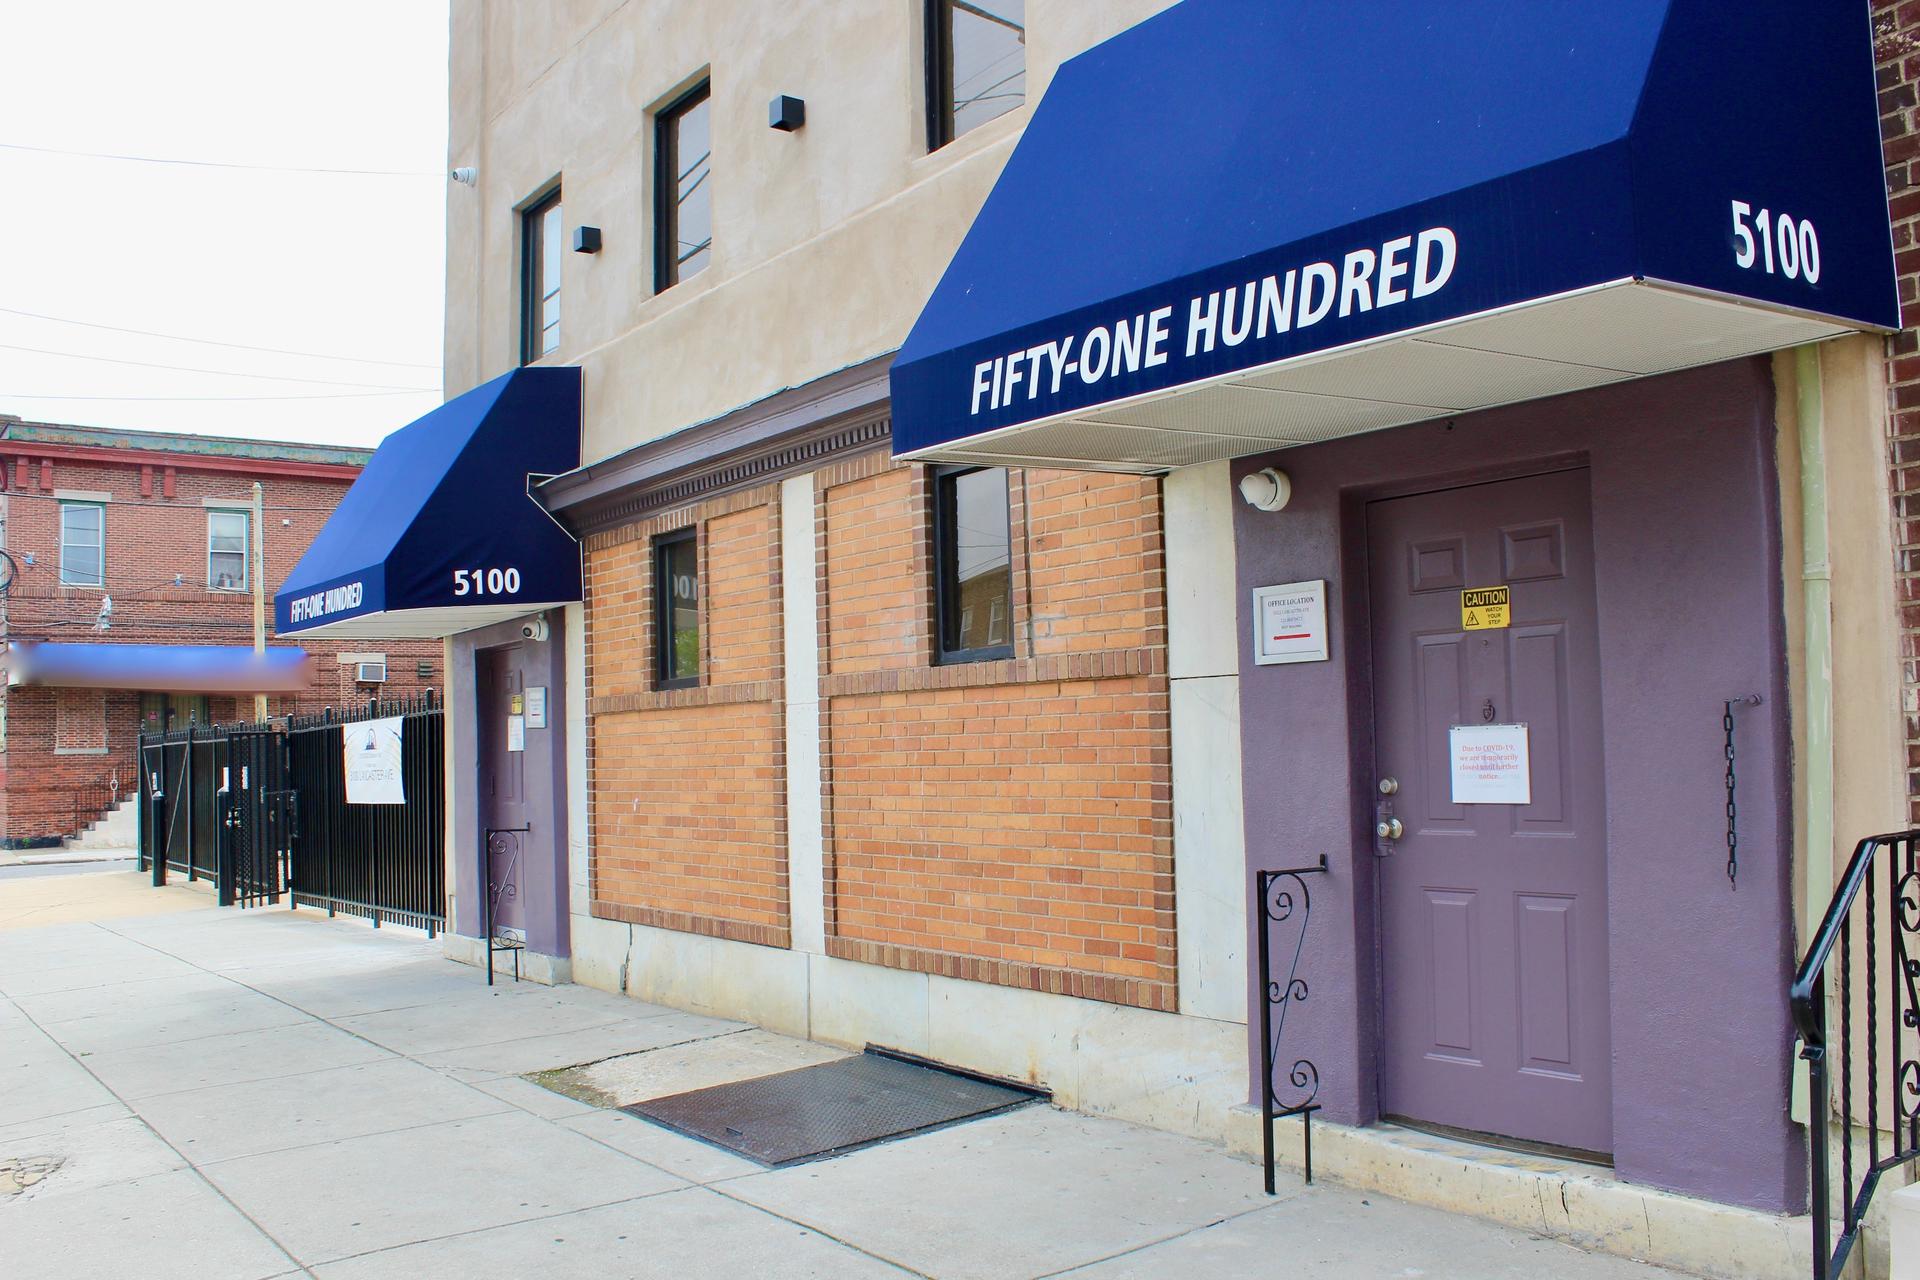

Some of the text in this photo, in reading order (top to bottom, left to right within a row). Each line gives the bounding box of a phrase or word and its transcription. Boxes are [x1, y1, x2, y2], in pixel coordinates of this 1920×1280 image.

[1731, 199, 1820, 284] 5100
[970, 226, 1457, 415] FIFTY-ONE HUNDRED
[454, 567, 521, 596] 5100
[1465, 590, 1505, 606] CAUTION
[290, 581, 363, 624] FIFTY-ONE HUNDRED
[1286, 597, 1314, 605] LOCATION
